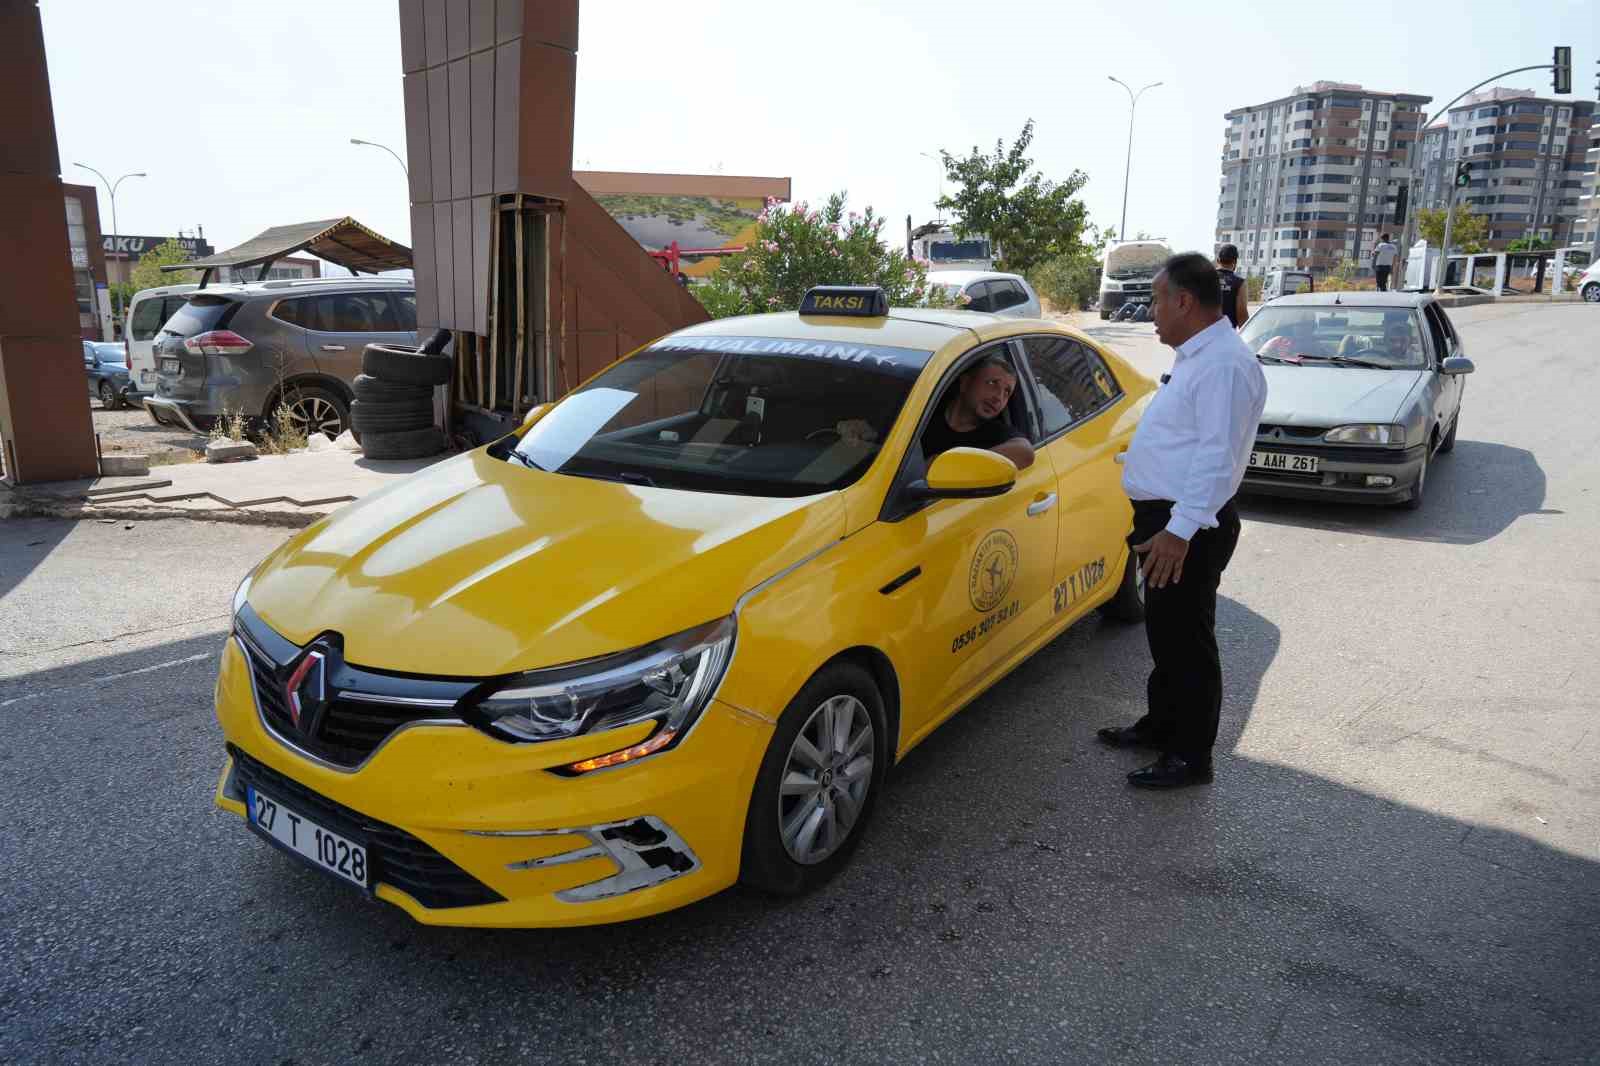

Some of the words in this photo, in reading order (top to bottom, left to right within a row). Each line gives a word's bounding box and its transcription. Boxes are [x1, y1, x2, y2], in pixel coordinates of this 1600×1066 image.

[1263, 454, 1287, 468] AAH
[1292, 456, 1316, 471] 261
[1055, 580, 1068, 614] 27
[1078, 557, 1105, 593] 1028
[256, 795, 277, 831] 27
[287, 813, 301, 848] T
[315, 828, 365, 882] 1028
